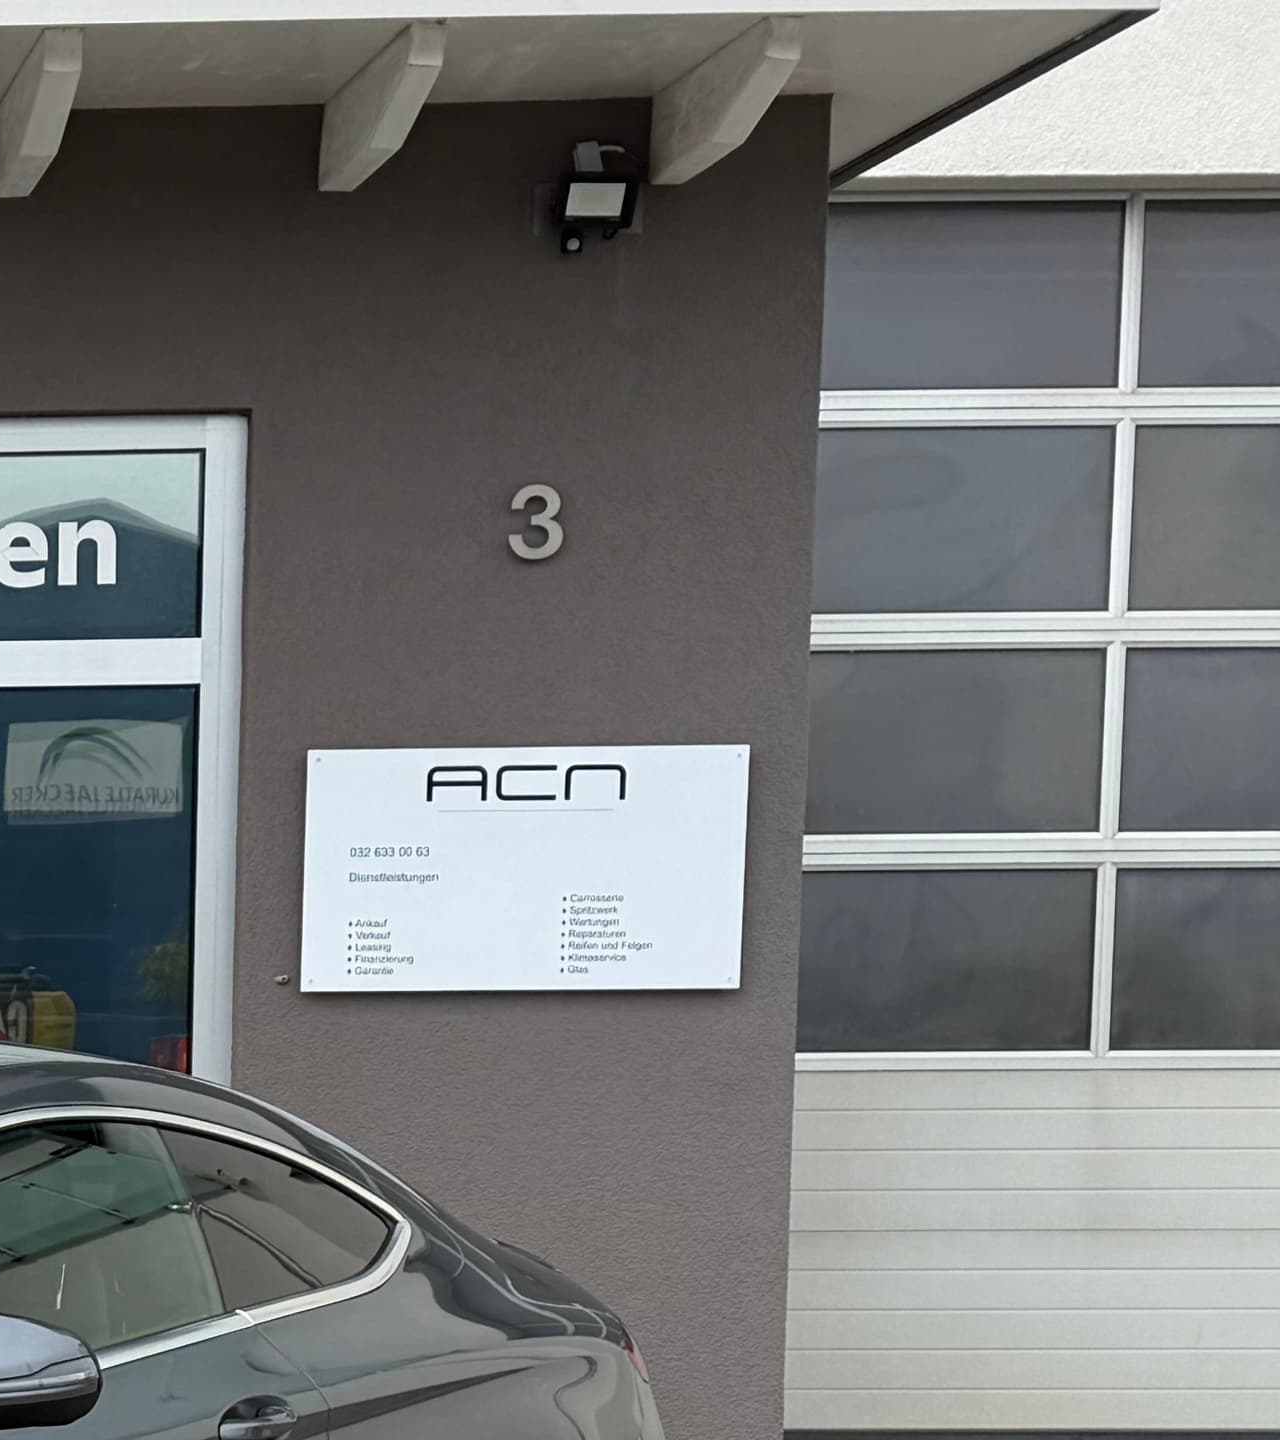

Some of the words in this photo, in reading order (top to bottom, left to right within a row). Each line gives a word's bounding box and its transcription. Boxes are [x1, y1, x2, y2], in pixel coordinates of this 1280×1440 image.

[508, 484, 564, 560] 3
[426, 764, 627, 802] ACN
[350, 848, 370, 857] 032
[374, 847, 395, 857] 633
[399, 847, 412, 857] 00
[416, 847, 430, 857] 63
[349, 873, 439, 884] Dienstleistungen
[355, 919, 387, 927] Ankauf
[356, 931, 391, 939] Verkauf
[355, 944, 391, 952] Leasing
[601, 941, 618, 950] und
[355, 956, 414, 964] Finanzierung
